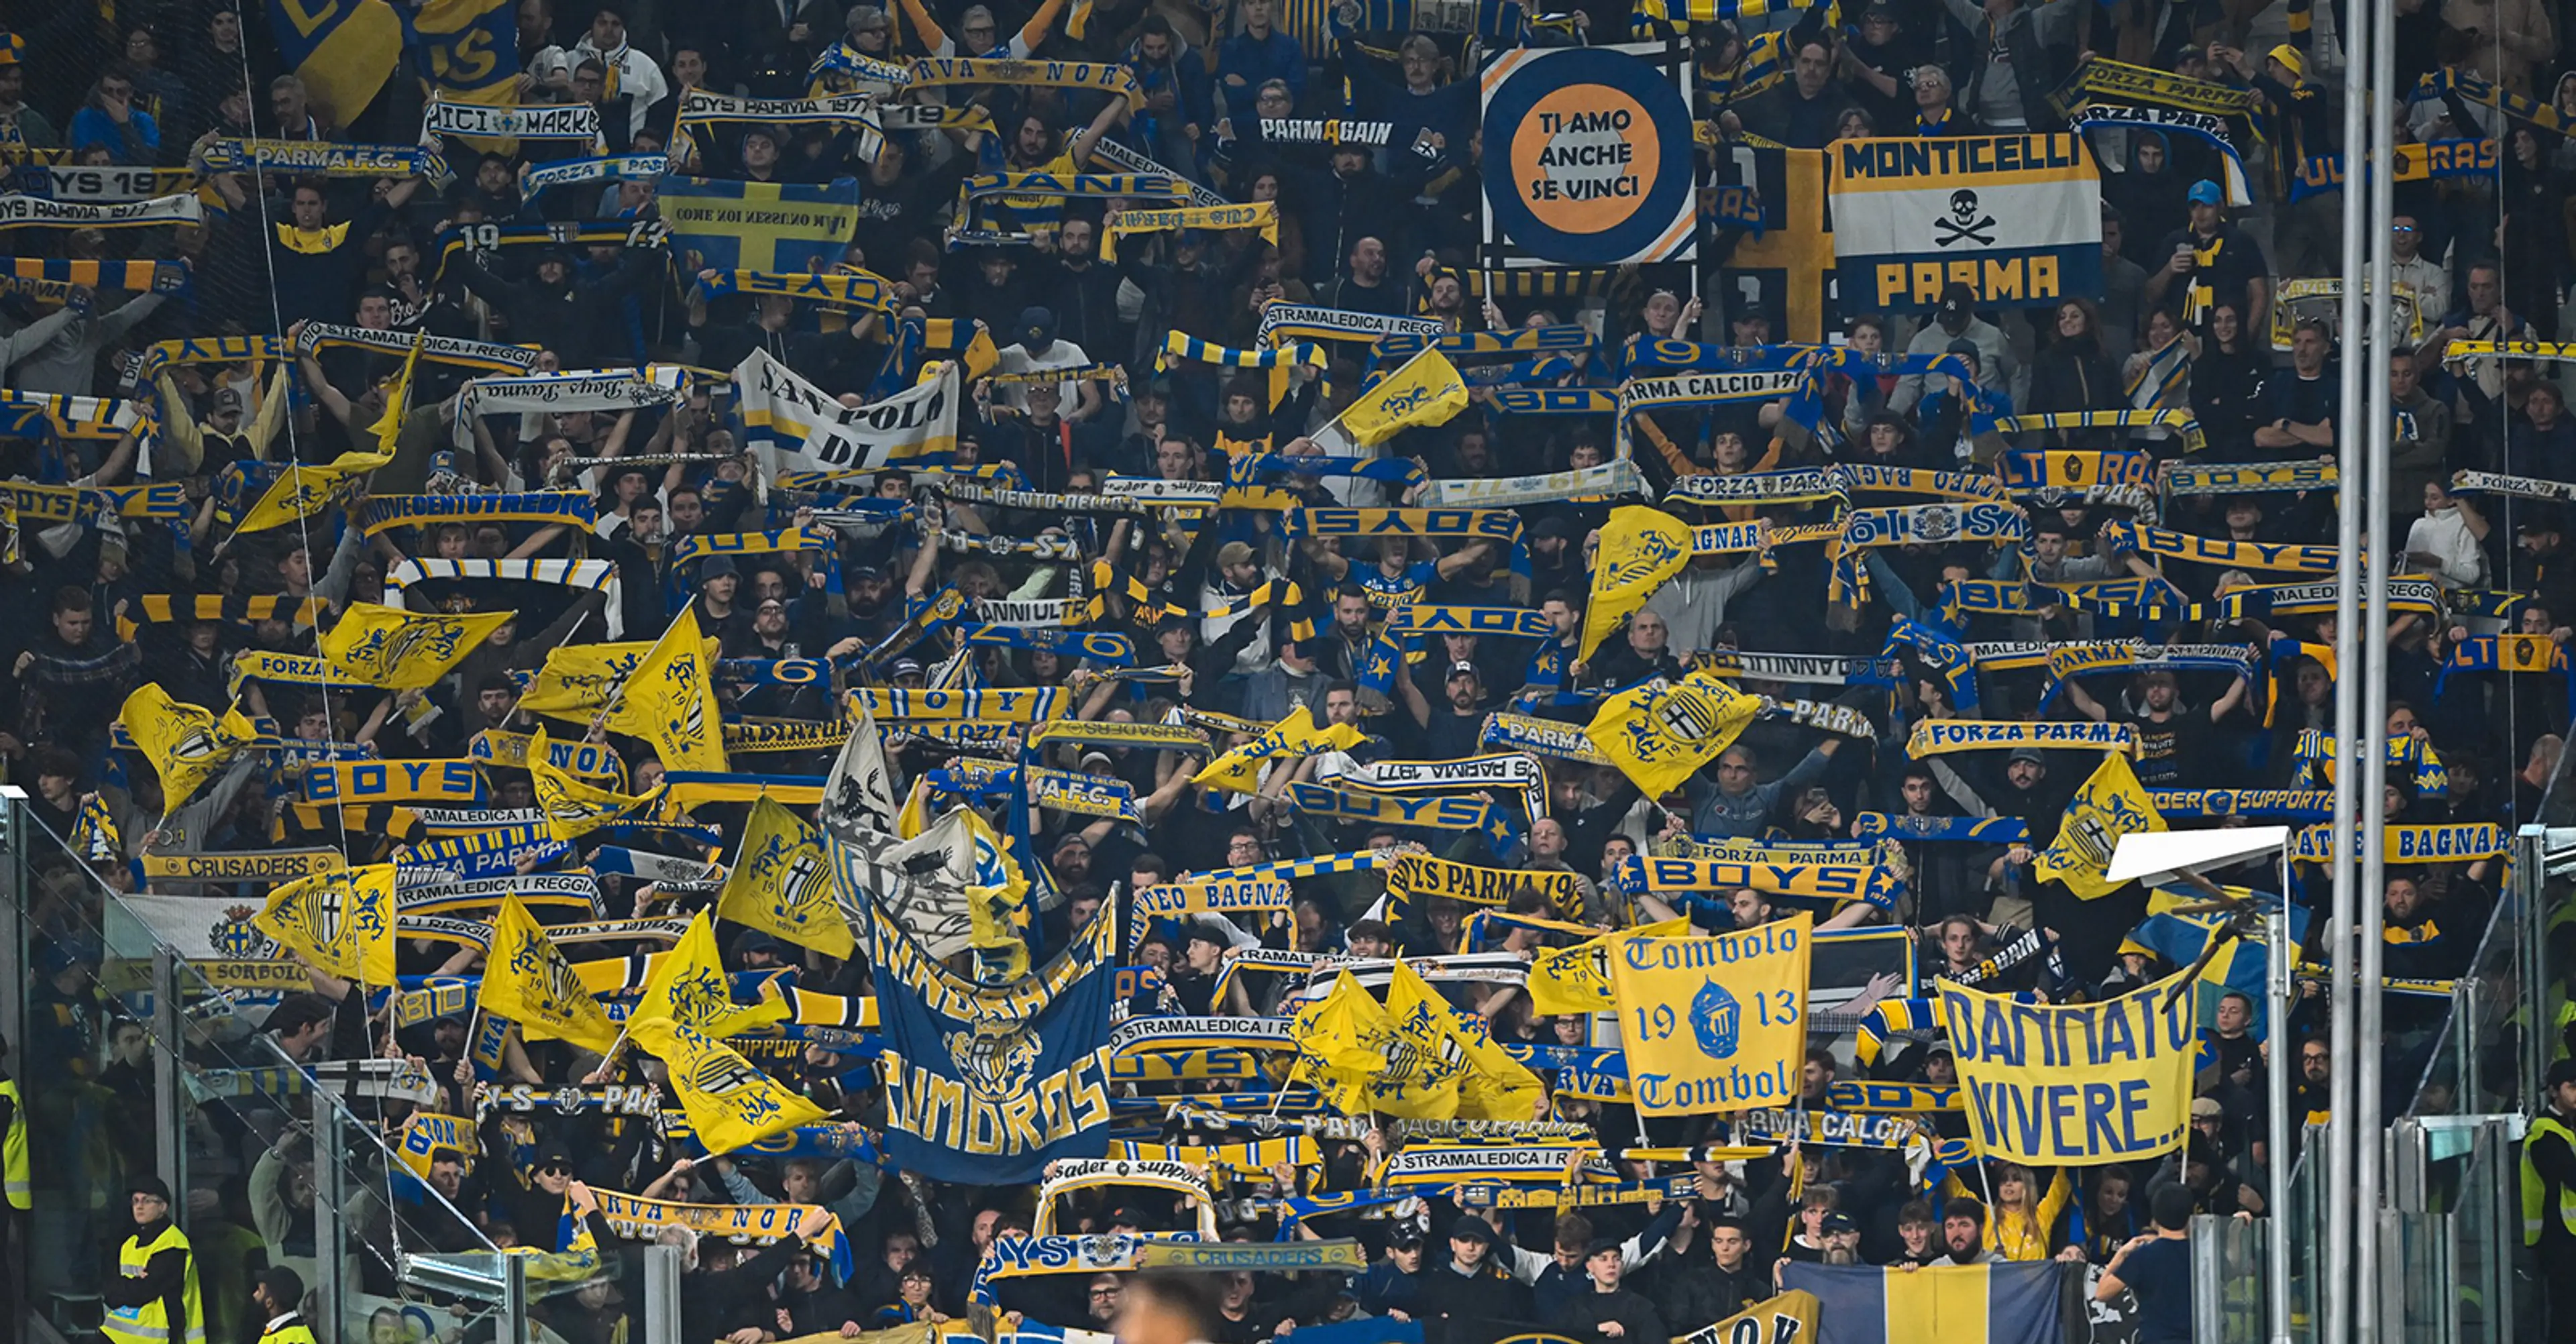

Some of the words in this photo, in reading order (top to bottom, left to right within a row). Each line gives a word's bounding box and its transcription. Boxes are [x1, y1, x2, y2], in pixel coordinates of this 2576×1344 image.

[1045, 62, 1138, 91] NORD
[2085, 65, 2155, 90] FORZA
[2165, 82, 2251, 107] PARMA
[744, 99, 818, 114] PARMA
[1260, 118, 1393, 146] PARMAGAIN
[1539, 113, 1560, 134] TI
[1569, 109, 1632, 133] AMO
[257, 148, 347, 168] PARMA
[355, 152, 399, 170] F.C.
[1538, 143, 1632, 167] ANCHE
[1843, 133, 2080, 179] MONTICELLI
[537, 165, 595, 183] FORZA
[1530, 178, 1558, 201] SE
[1569, 176, 1639, 200] VINCI
[34, 201, 100, 219] PARMA
[459, 224, 500, 251] 19
[1876, 255, 2059, 307] PARMA
[1269, 307, 1383, 331] STRAMALEDICA
[303, 322, 322, 345] DIO
[1688, 373, 1763, 396] CALCIO
[760, 361, 826, 417] SAN
[837, 392, 945, 433] POLO
[818, 431, 875, 473] DI
[1688, 475, 1758, 494] FORZA
[2171, 466, 2321, 488] BOYS
[2482, 476, 2532, 493] FORZA
[1314, 508, 1519, 537] BOYS
[2146, 528, 2340, 569] BOYS
[981, 601, 1026, 622] ANNI
[262, 658, 323, 676] FORZA
[2051, 646, 2129, 674] PARMA
[1081, 722, 1201, 740] CRUSADERS
[1509, 723, 1594, 753] PARMA
[1931, 724, 2022, 744] FORZA
[2034, 723, 2131, 744] PARMA
[307, 761, 472, 797] BOYS
[1429, 762, 1507, 779] PARMA
[1296, 783, 1484, 825] BOYS
[187, 856, 309, 877] CRUSADERS
[1704, 846, 1770, 864] FORZA
[1789, 850, 1862, 866] PARMA
[1655, 859, 1862, 895] BOYS
[1870, 890, 1892, 906] 1977
[1624, 927, 1798, 972] Tombolo
[218, 964, 309, 981] SORBOLO
[529, 975, 544, 991] 19
[1573, 970, 1588, 983] 19
[1635, 1001, 1677, 1042] 19
[1754, 988, 1800, 1027] 13
[1947, 981, 2194, 1067] DANNATO
[1124, 1016, 1261, 1040] STRAMALEDICA
[1969, 1075, 2186, 1158] VIVERE...
[1405, 1150, 1540, 1170] STRAMALEDICA
[1193, 1247, 1322, 1268] CRUSADERS
